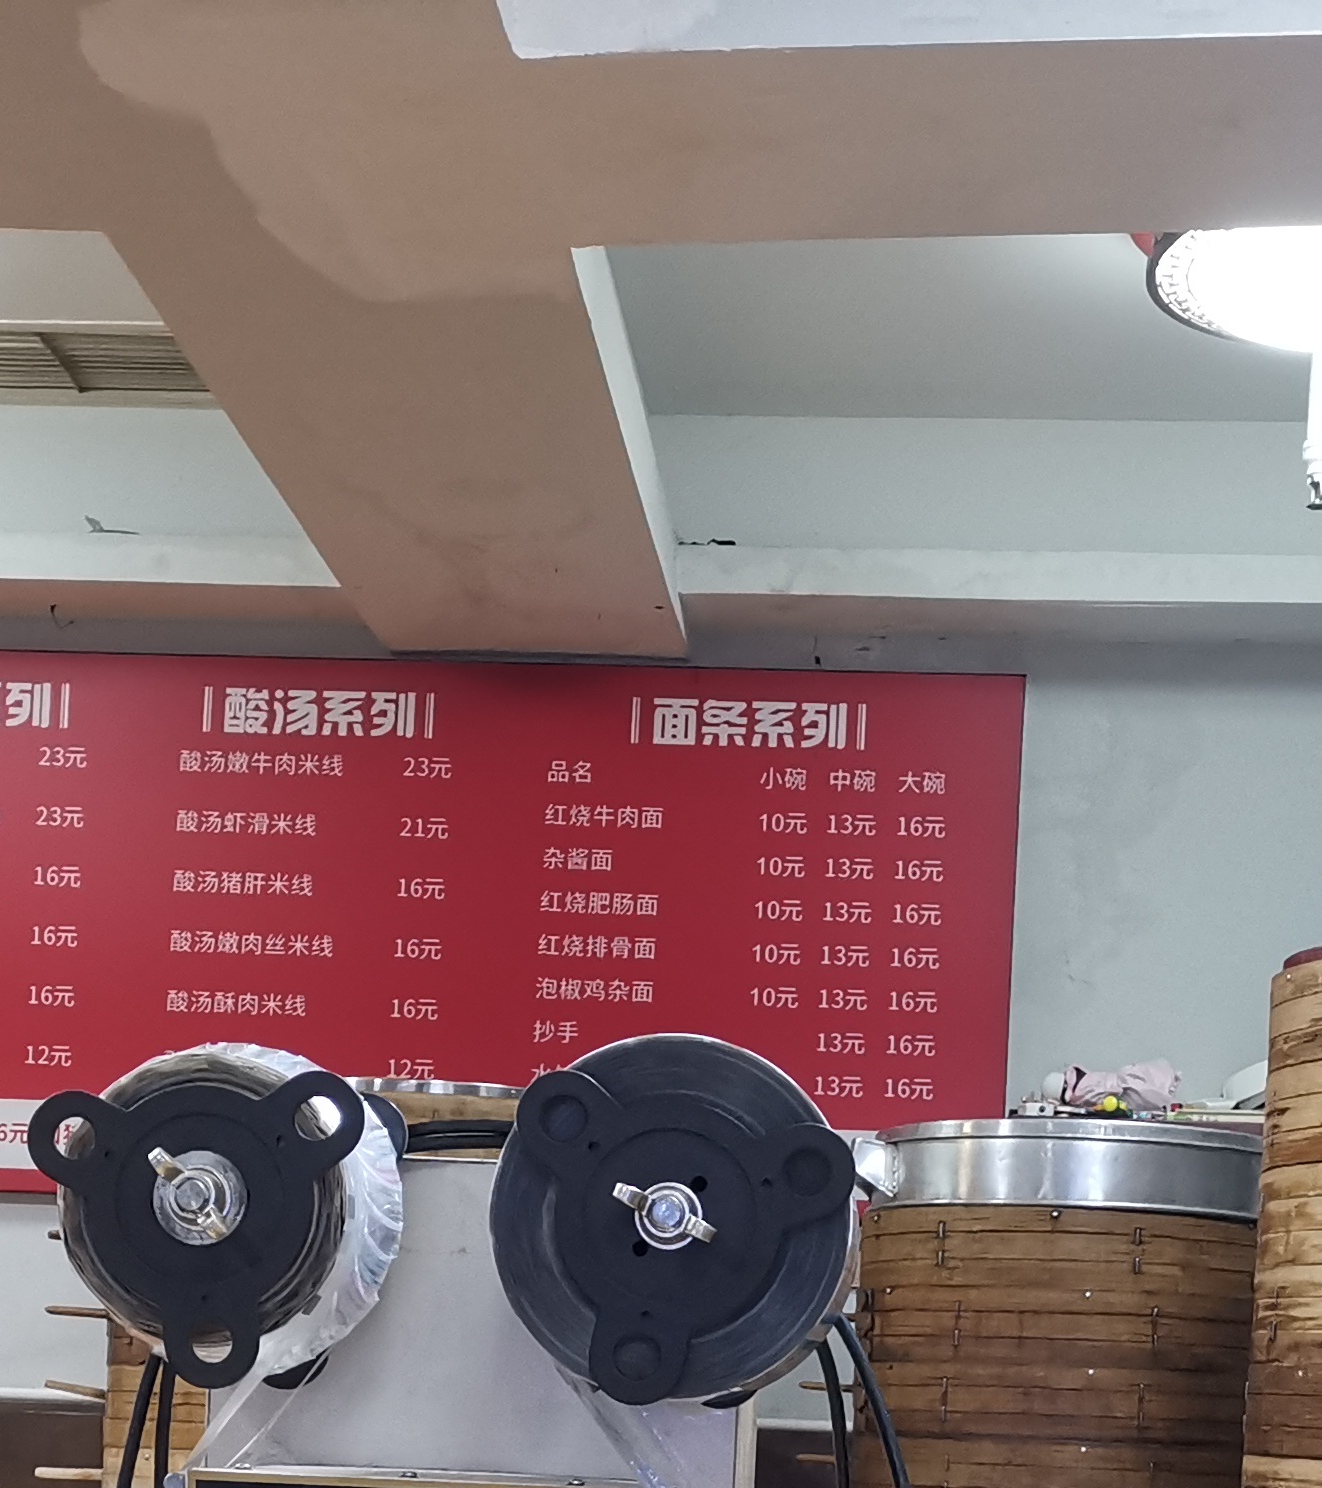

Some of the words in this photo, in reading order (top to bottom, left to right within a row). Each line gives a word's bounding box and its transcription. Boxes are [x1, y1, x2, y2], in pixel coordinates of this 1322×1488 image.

[223, 687, 416, 738] 酸汤系列
[653, 698, 848, 750] 面条系列
[38, 747, 87, 768] 23元
[178, 750, 343, 776] 酸汤嫩牛肉米线
[403, 757, 452, 778] 23元
[548, 761, 591, 783] 品名
[760, 767, 807, 790] 小碗
[830, 769, 876, 792] 中碗
[898, 770, 946, 795] 大碗
[36, 806, 84, 828] 23元
[176, 810, 316, 836] 酸汤虾滑米线
[400, 818, 448, 839] 21元
[545, 804, 663, 828] 红烧牛肉面
[760, 813, 807, 834] 10元
[827, 814, 876, 836] 13元
[897, 816, 945, 838] 16元
[34, 866, 84, 889] 16元
[543, 847, 613, 871] 杂酱面
[757, 857, 805, 878] 10元
[825, 858, 874, 880] 13元
[894, 860, 944, 882] 16元
[173, 870, 312, 896] 酸汤猪肝米线
[397, 878, 445, 900] 16元
[540, 891, 658, 916] 红烧肥肠面
[755, 900, 802, 921] 10元
[823, 902, 872, 923] 13元
[892, 904, 941, 926] 16元
[30, 926, 78, 947] 16元
[170, 930, 333, 957] 酸汤嫩肉丝米线
[394, 939, 442, 960] 16元
[538, 934, 656, 959] 红烧排骨面
[752, 944, 800, 965] 10元
[821, 946, 869, 967] 13元
[890, 947, 941, 969] 16元
[28, 986, 75, 1007] 16元
[167, 990, 306, 1016] 酸汤酥肉米线
[391, 999, 438, 1020] 16元
[536, 977, 653, 1002] 泡椒鸡杂面
[750, 987, 798, 1008] 10元
[819, 989, 868, 1010] 13元
[888, 991, 937, 1013] 16元
[533, 1020, 578, 1043] 抄手
[817, 1033, 865, 1054] 13元
[886, 1035, 935, 1056] 16元
[25, 1045, 72, 1067] 12元
[386, 1058, 435, 1080] 12元
[813, 1076, 863, 1098] 13元
[884, 1078, 933, 1100] 16元
